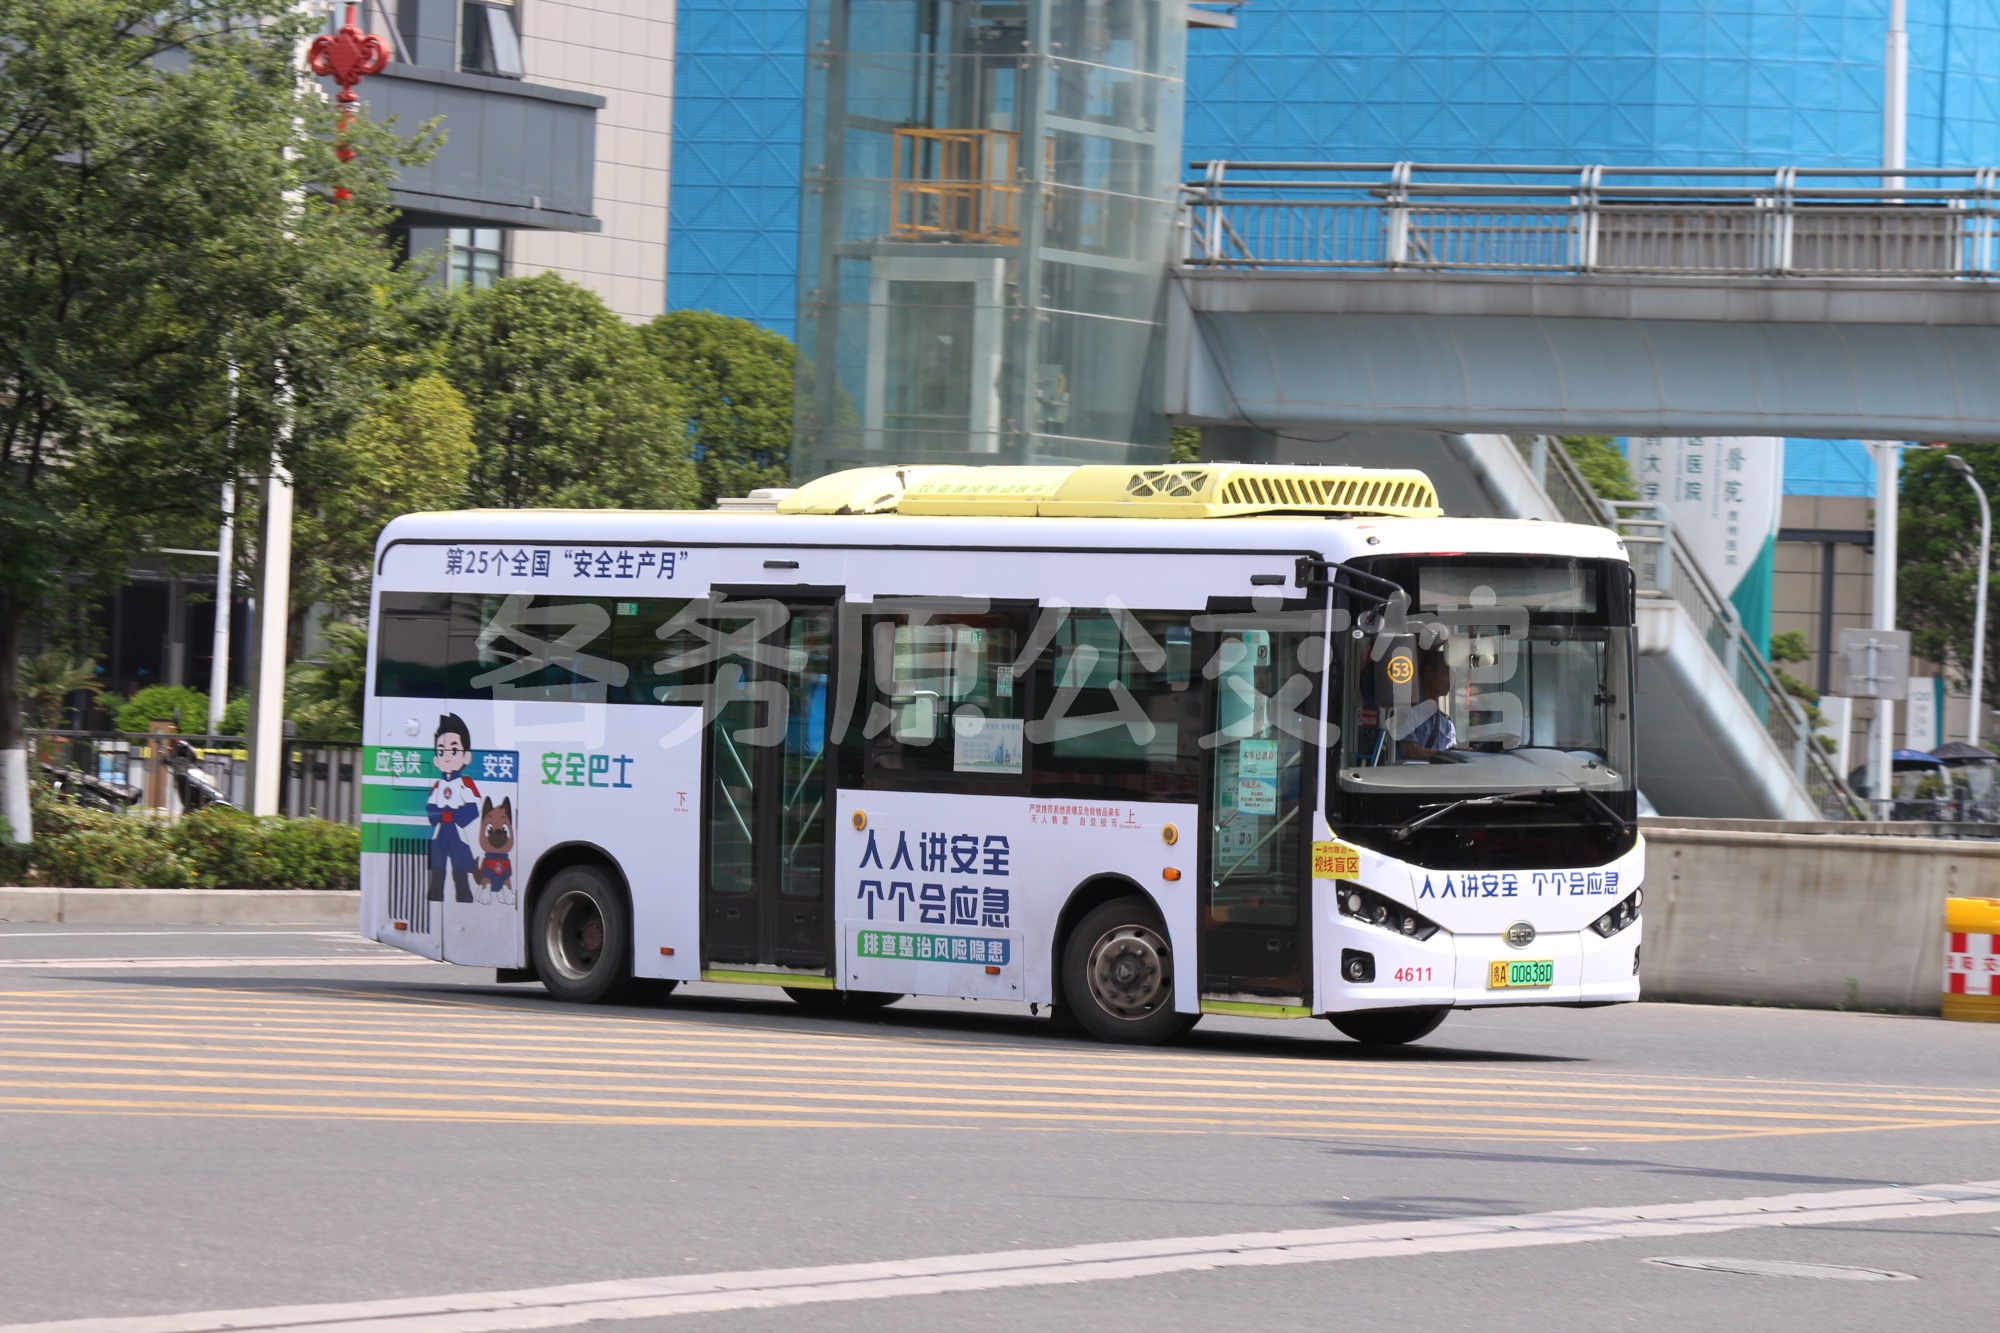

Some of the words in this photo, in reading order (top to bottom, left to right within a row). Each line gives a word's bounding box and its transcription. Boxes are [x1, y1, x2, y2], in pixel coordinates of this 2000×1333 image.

[1391, 662, 1410, 678] 53
[375, 750, 421, 777] 应急侠
[482, 754, 515, 779] 安安
[541, 752, 634, 789] 安全巴士
[676, 791, 687, 806] 下
[1125, 808, 1136, 824] 上
[859, 829, 1010, 876] 人人讲安全
[1315, 856, 1359, 873] 视线盲区
[1419, 873, 1518, 898] 人人讲安全
[1532, 871, 1620, 896] 个个会应急
[857, 880, 1010, 929] 个个会应急
[1509, 928, 1533, 942] BYD
[863, 932, 1004, 963] 排查整治风险隐患
[1394, 966, 1432, 982] 4611
